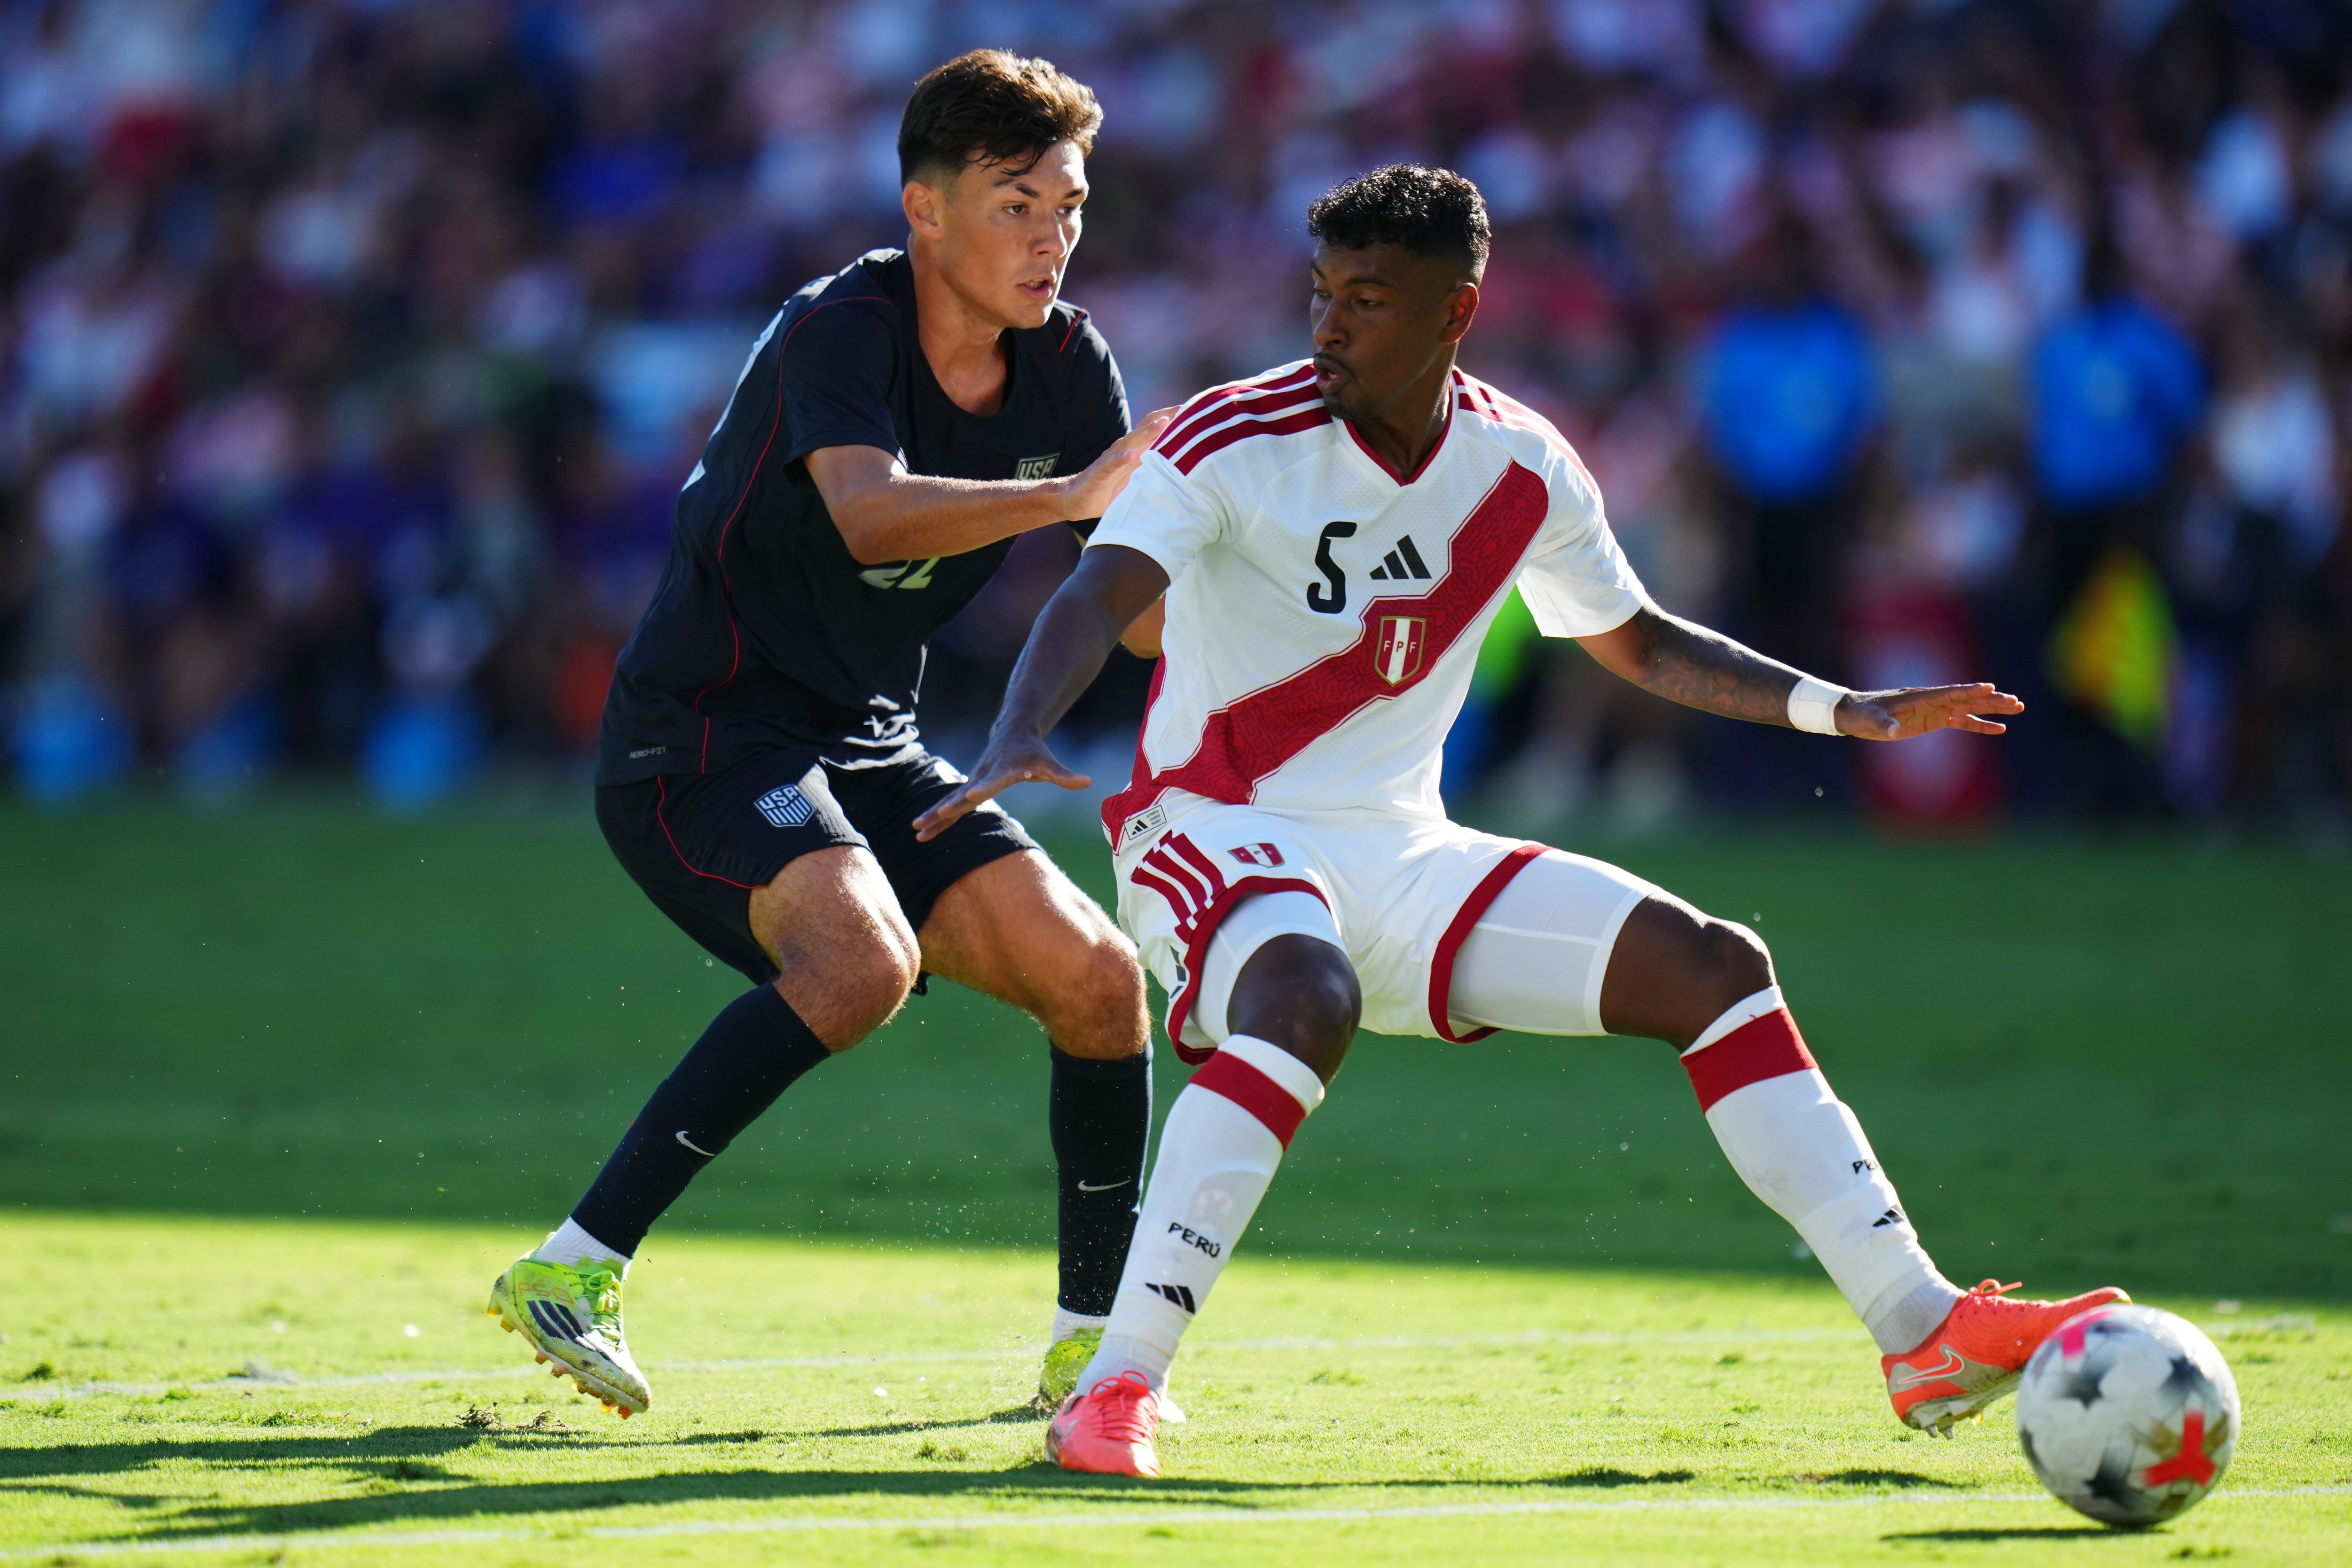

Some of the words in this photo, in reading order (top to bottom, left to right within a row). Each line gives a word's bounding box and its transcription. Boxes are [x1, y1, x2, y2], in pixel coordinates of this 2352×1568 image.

[1019, 458, 1056, 480] USA
[1307, 521, 1357, 614] 5
[1383, 640, 1417, 653] FPF
[759, 786, 799, 810] USA
